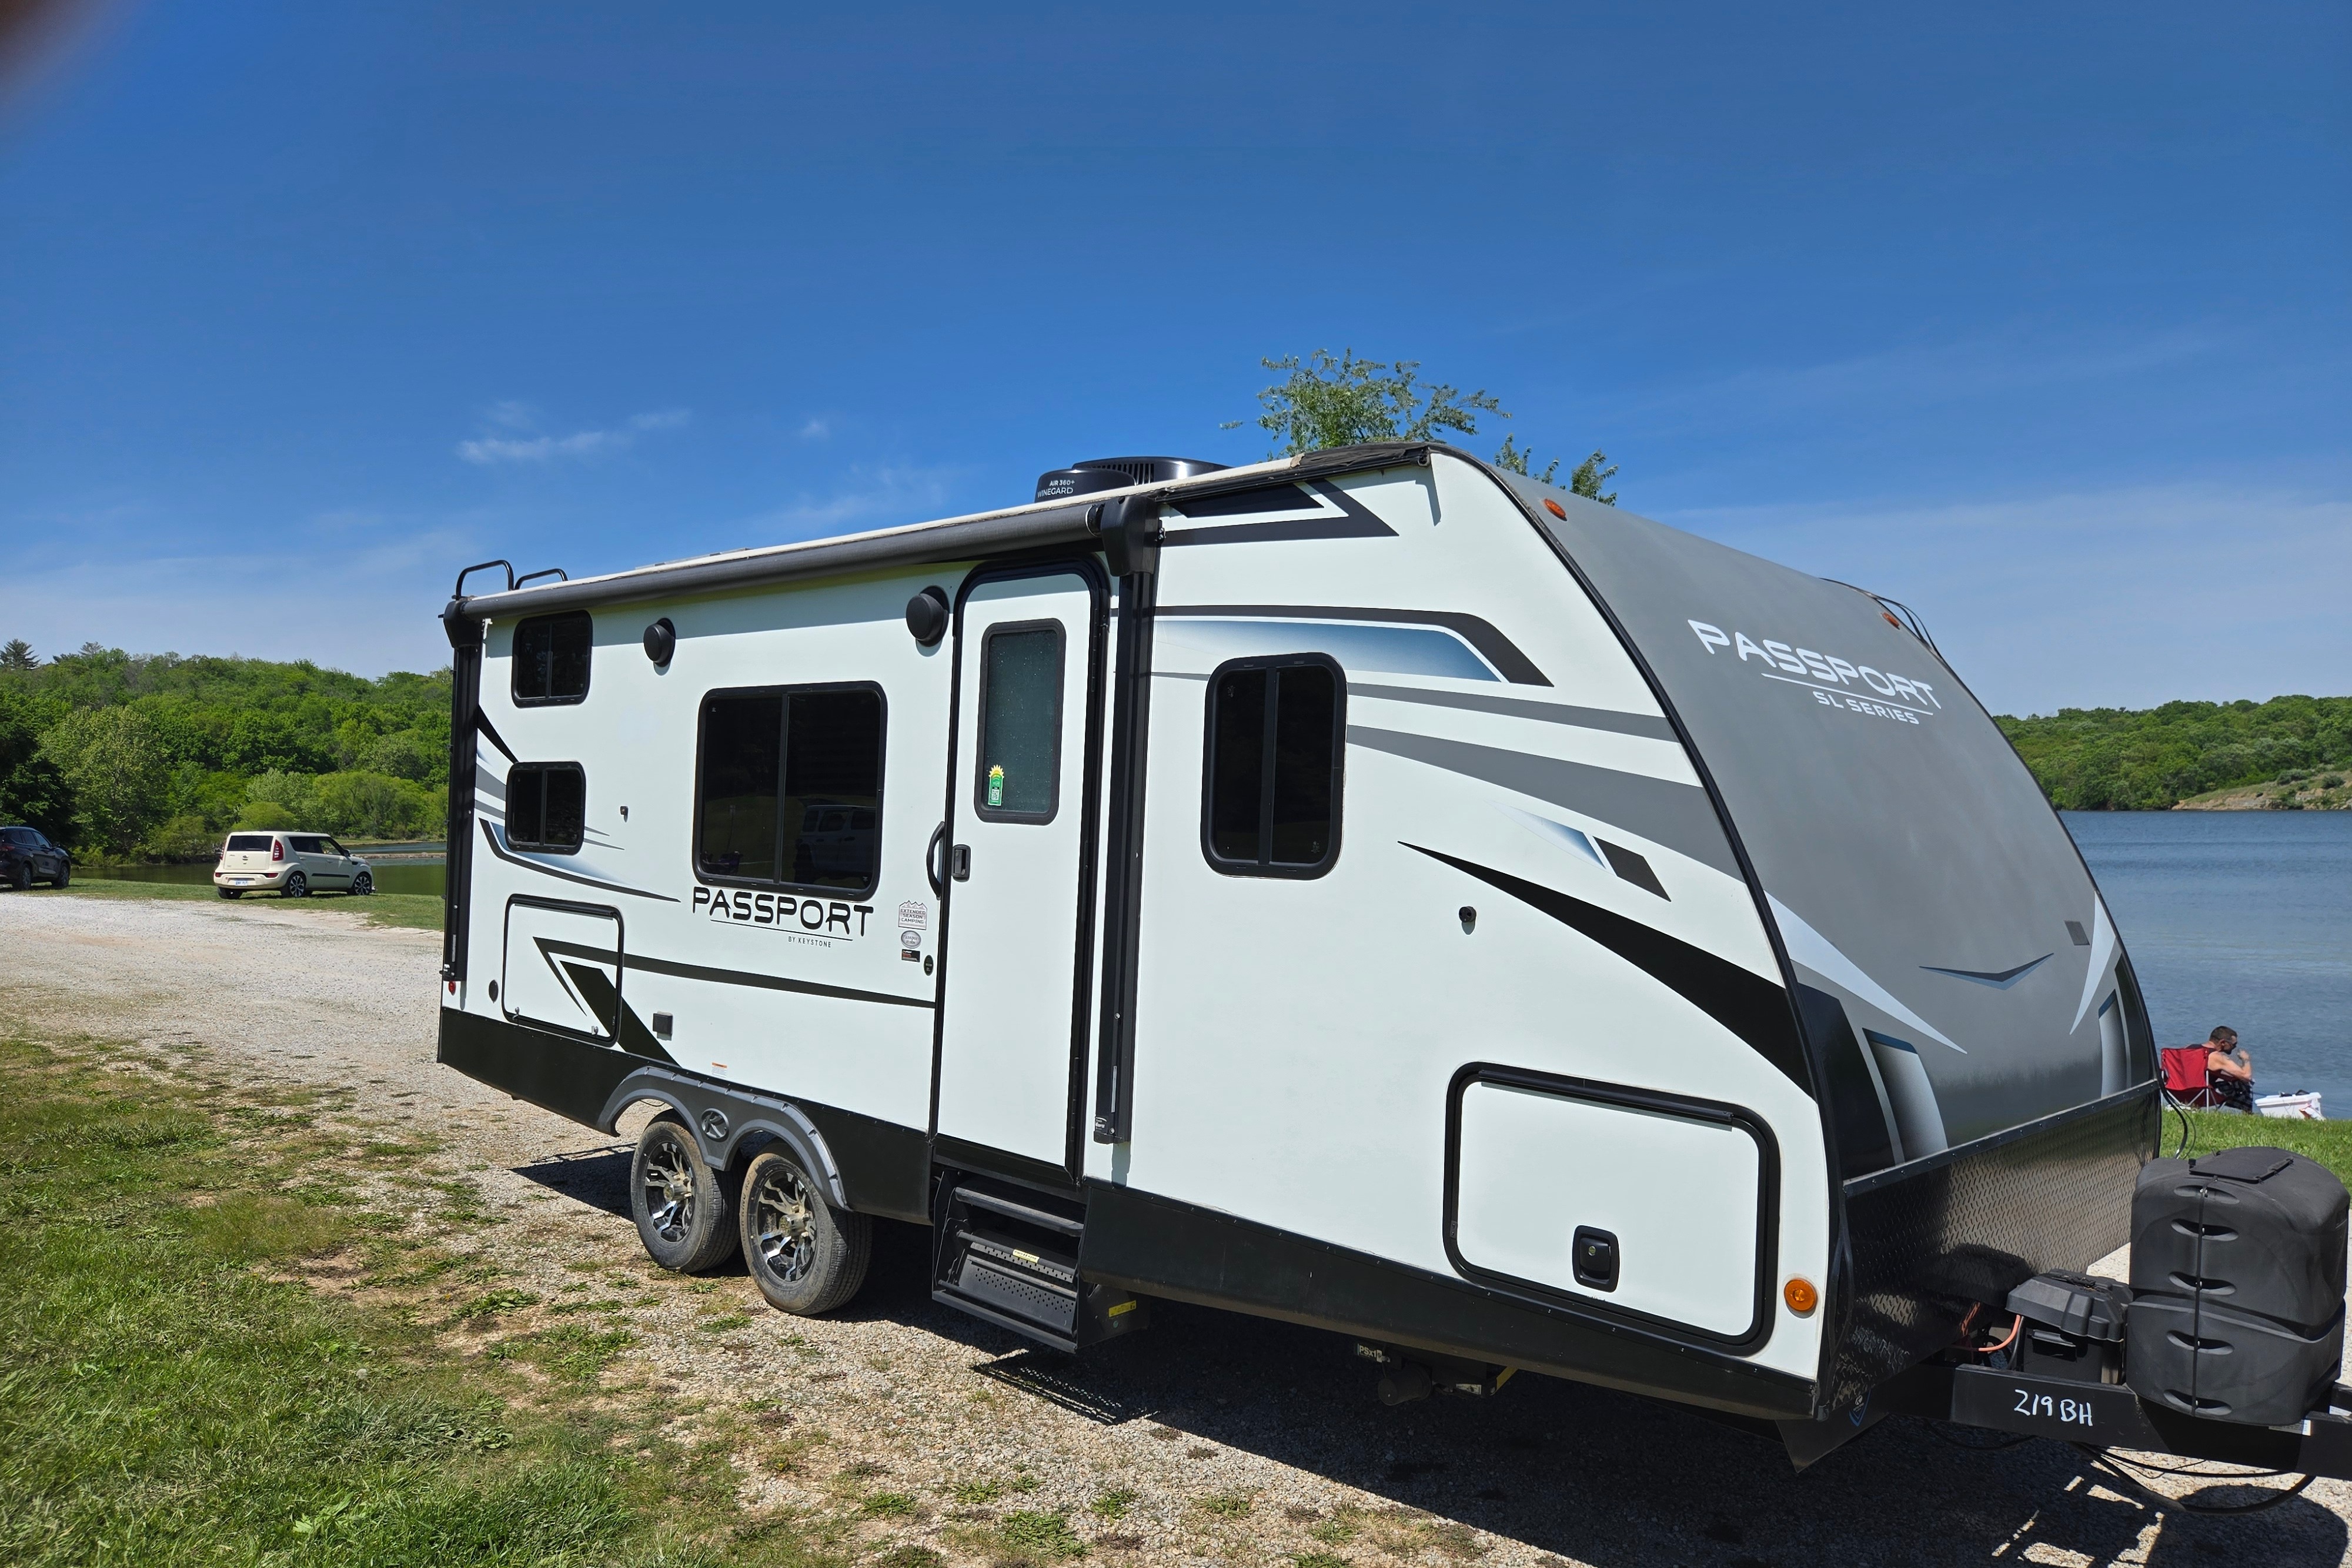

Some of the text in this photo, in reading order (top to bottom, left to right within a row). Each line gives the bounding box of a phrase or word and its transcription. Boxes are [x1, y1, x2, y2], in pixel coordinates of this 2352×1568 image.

[1038, 487, 1074, 498] WINEGARD
[1688, 619, 1942, 709] PASSPORT
[1813, 691, 1919, 724] SL SERIES
[693, 886, 874, 937] PASSPORT
[798, 937, 831, 948] KEYSTONE
[2060, 1399, 2093, 1426] BH
